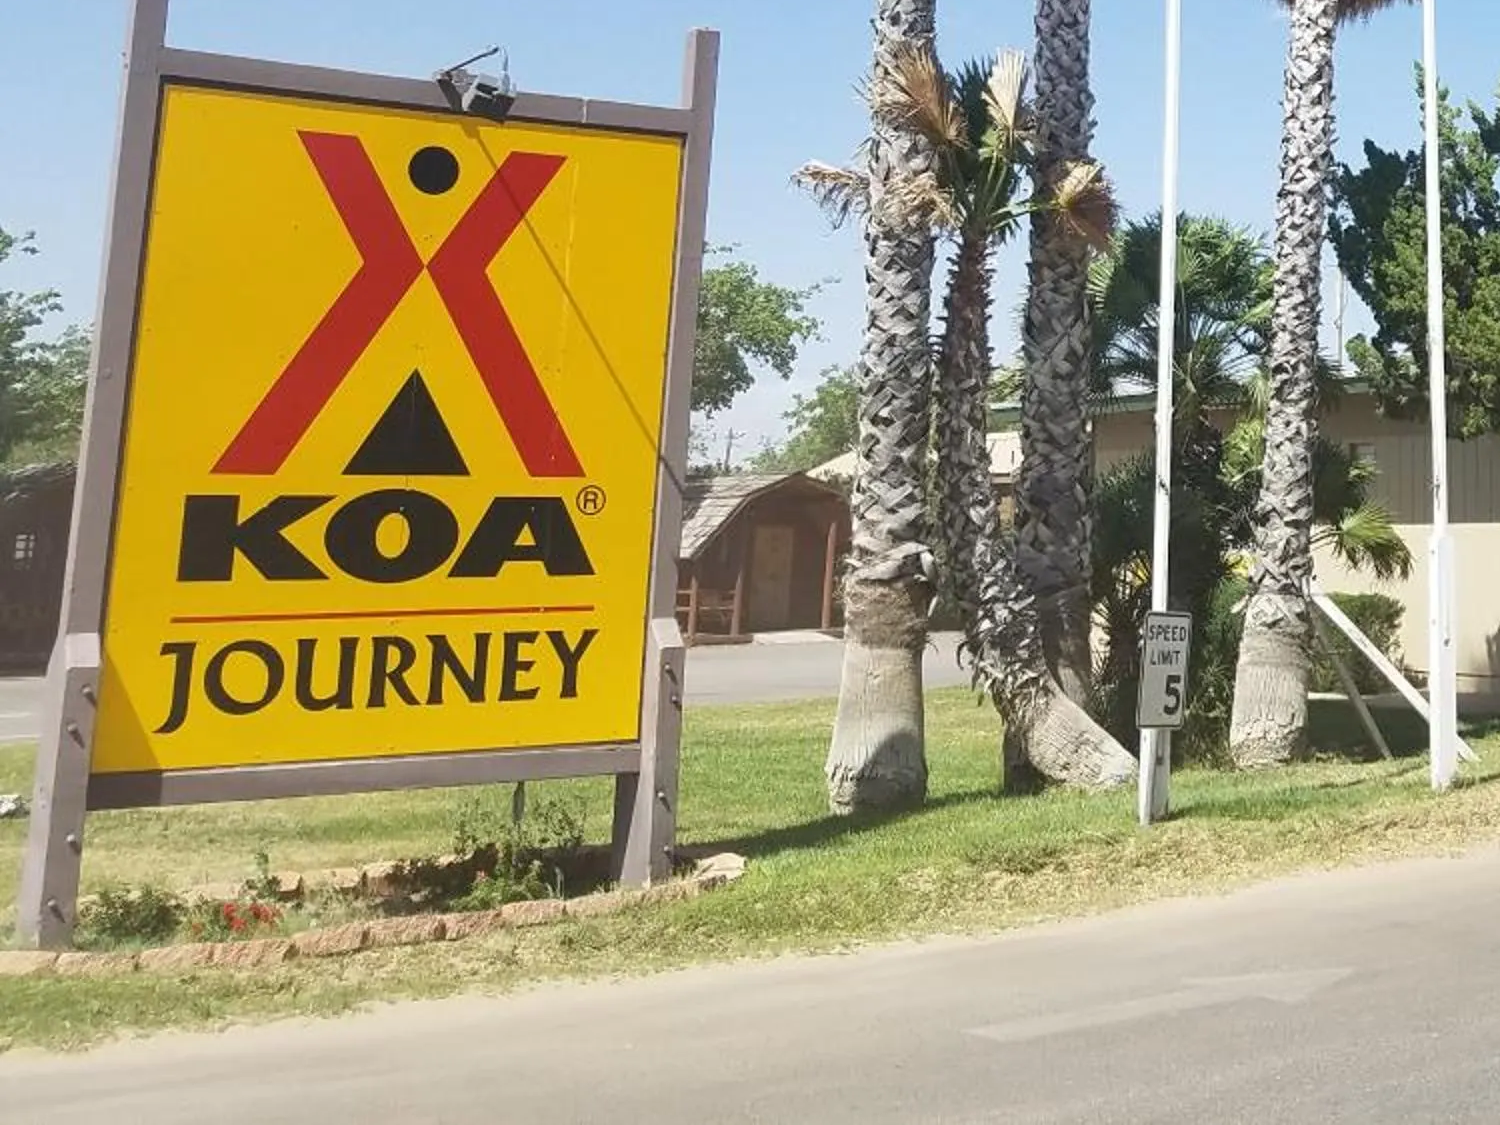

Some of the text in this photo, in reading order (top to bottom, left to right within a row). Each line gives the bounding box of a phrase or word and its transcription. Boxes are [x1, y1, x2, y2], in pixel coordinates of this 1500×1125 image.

[177, 488, 595, 584] KOA
[1148, 626, 1187, 642] SPEED
[1150, 650, 1181, 666] LIMIT
[152, 628, 599, 734] JOURNEY
[1163, 674, 1181, 716] 5
